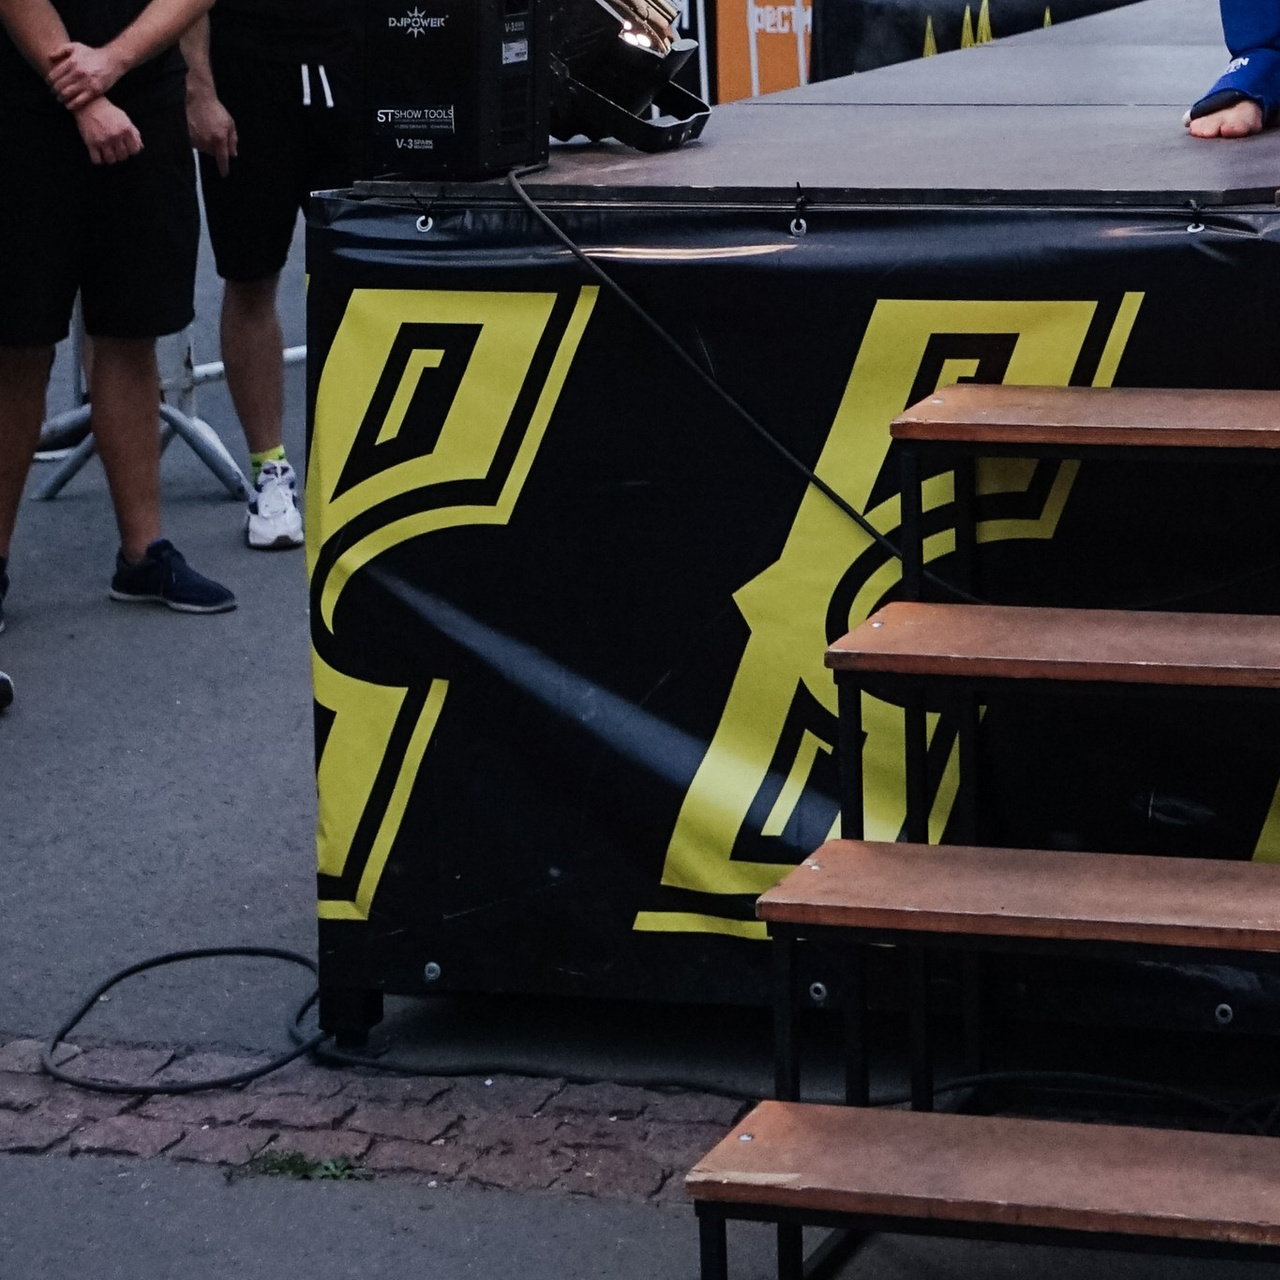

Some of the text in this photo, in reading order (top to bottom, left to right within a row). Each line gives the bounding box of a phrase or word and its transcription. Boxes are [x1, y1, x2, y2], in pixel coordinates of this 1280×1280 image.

[376, 109, 454, 123] ST SHOW TOOLS
[395, 138, 413, 149] V-3
